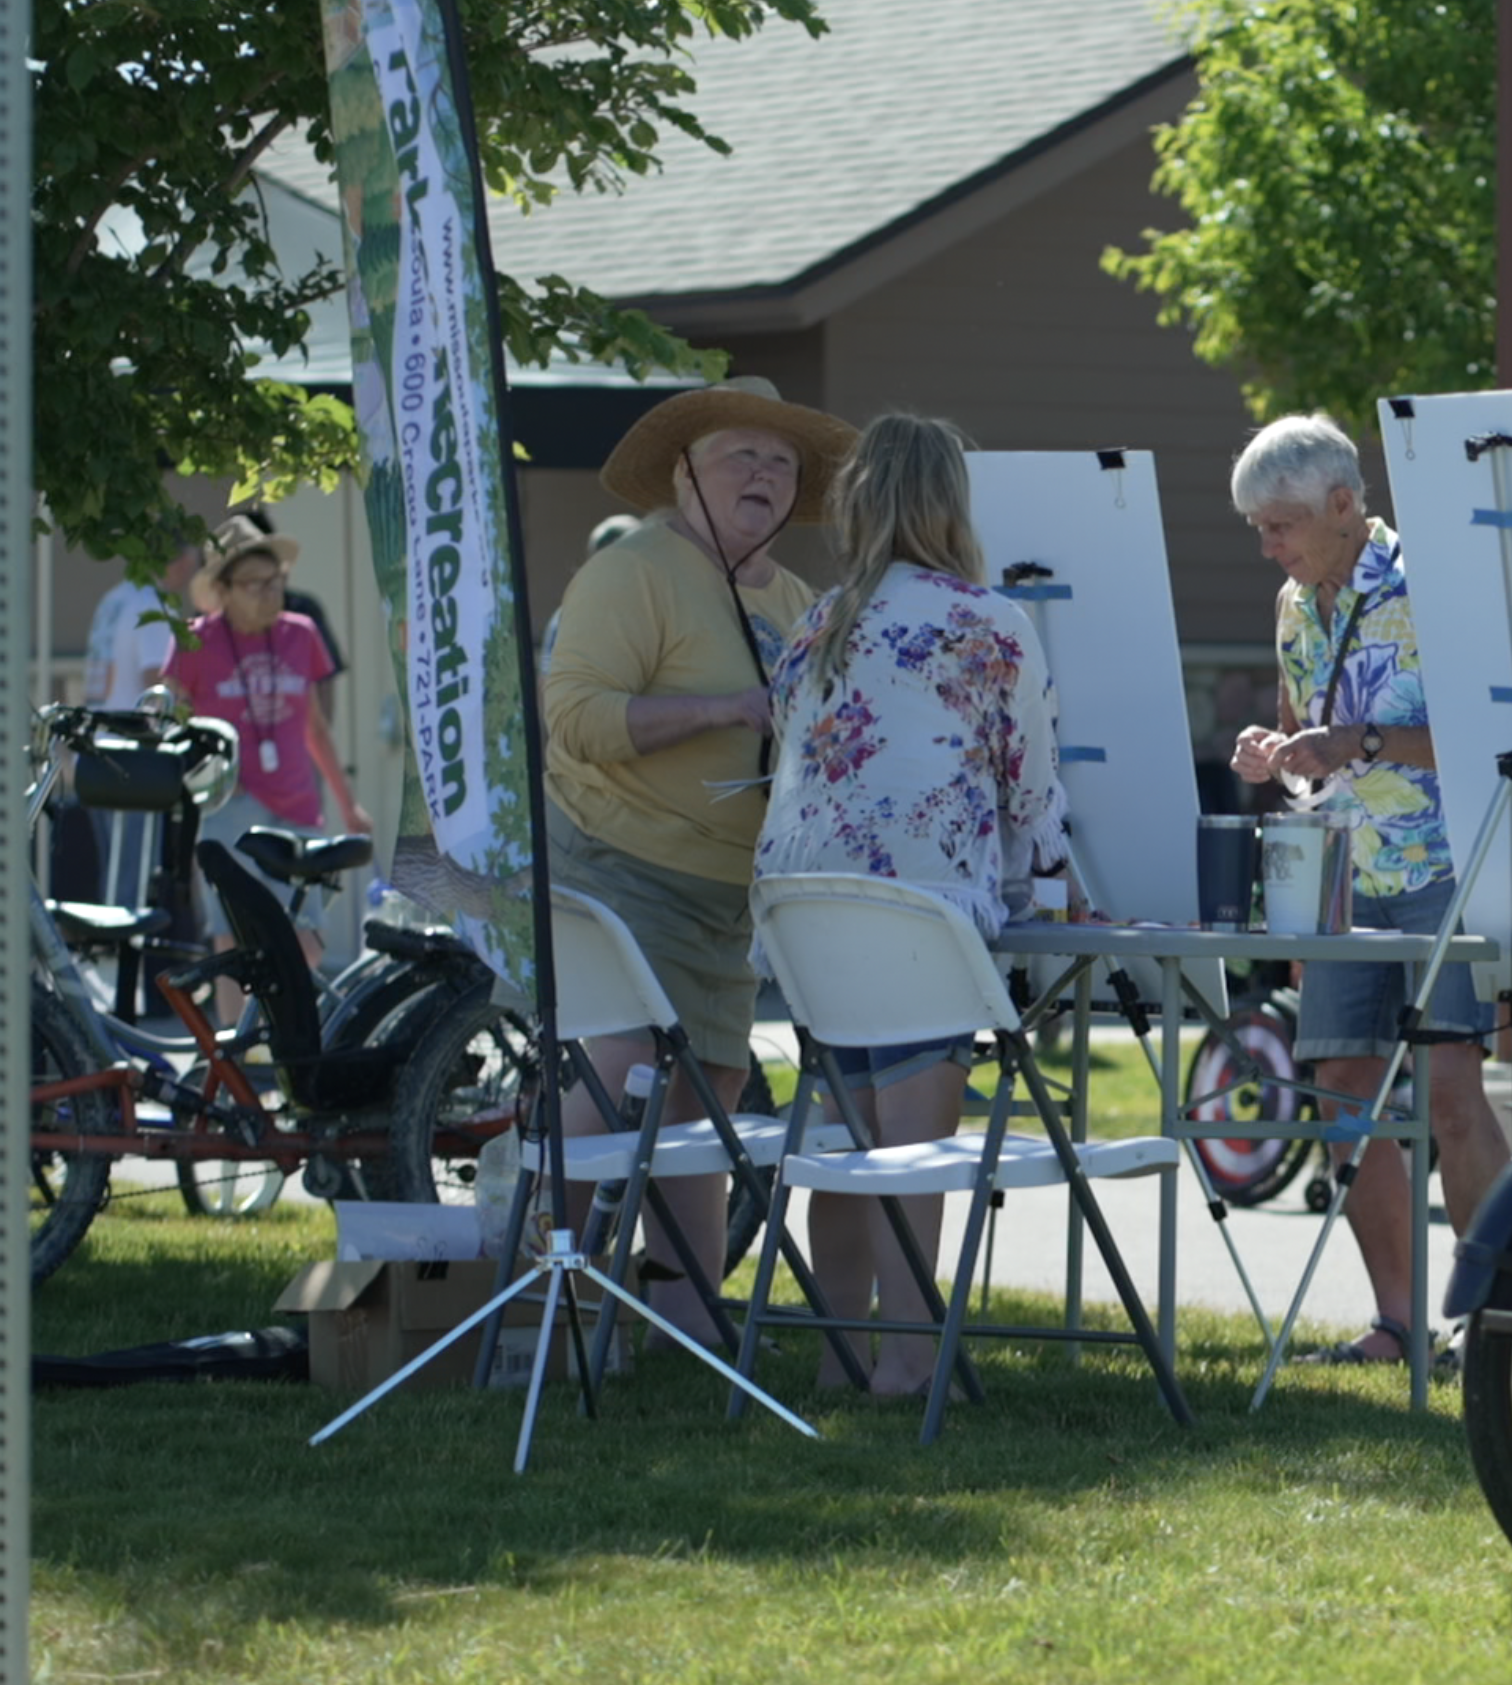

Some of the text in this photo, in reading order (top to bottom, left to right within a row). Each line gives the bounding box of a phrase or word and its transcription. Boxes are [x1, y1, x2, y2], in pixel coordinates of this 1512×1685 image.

[387, 49, 431, 285] ark
[408, 221, 426, 328] soula
[401, 352, 426, 412] 600
[415, 648, 441, 822] 721-PARK
